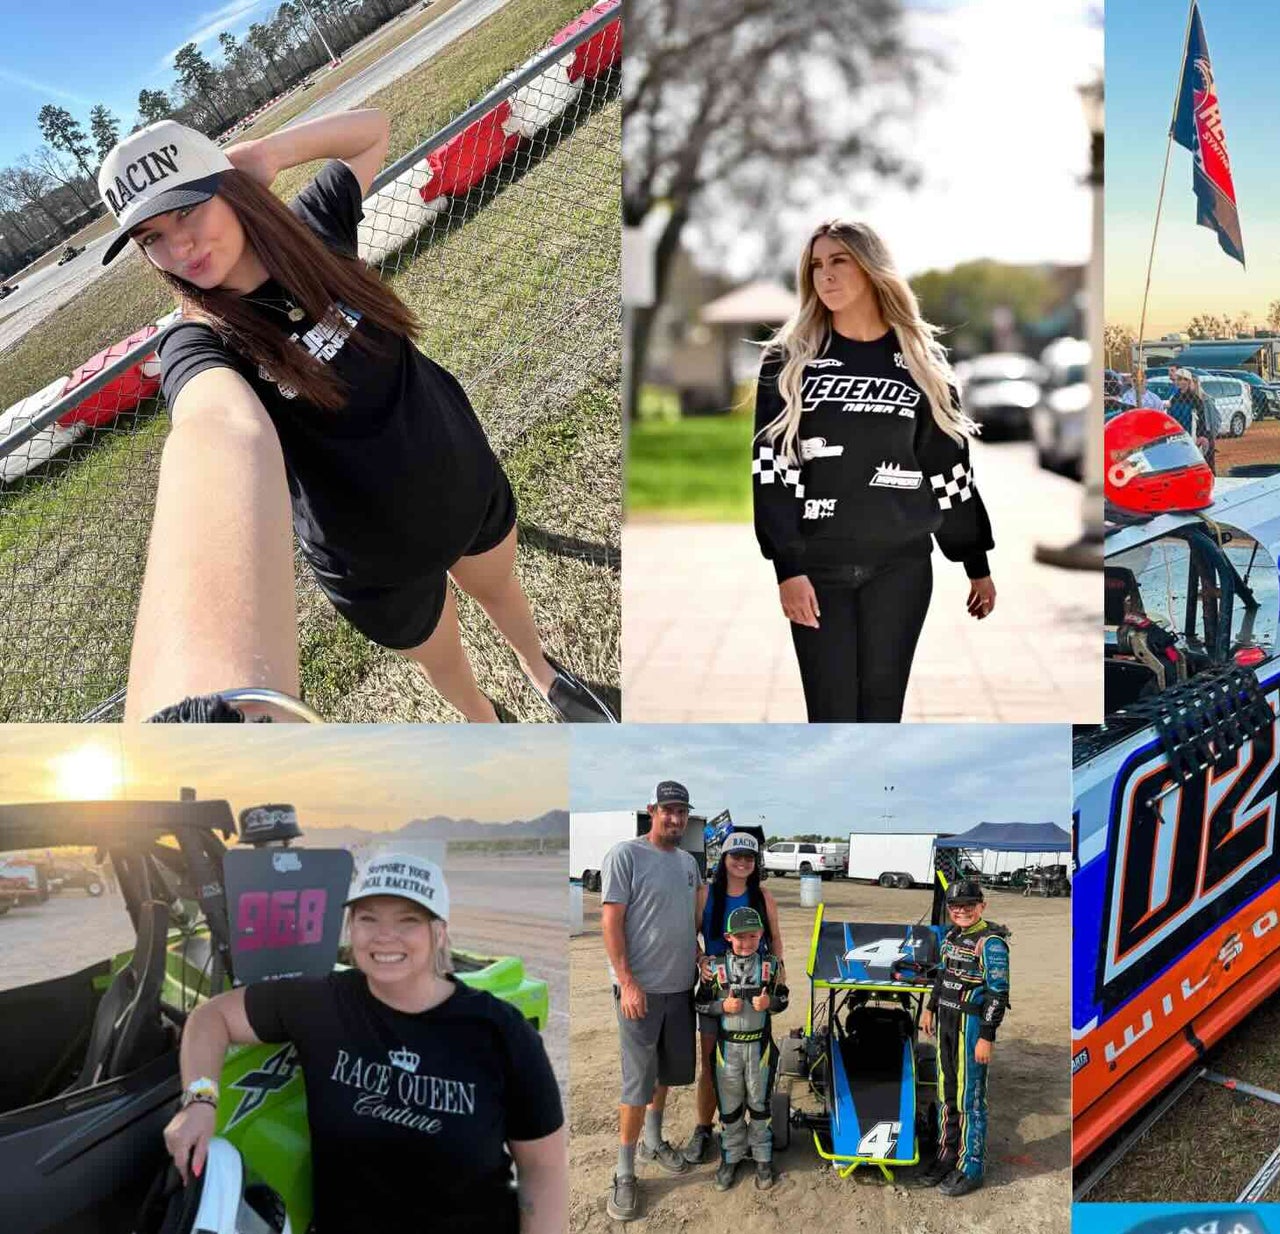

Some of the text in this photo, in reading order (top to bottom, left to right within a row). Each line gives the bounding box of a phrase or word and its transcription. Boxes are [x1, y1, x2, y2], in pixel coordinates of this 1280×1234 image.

[104, 143, 179, 218] RACIN'
[331, 1049, 477, 1115] RACE QUEEN
[352, 1093, 442, 1134] Couture
[856, 1121, 898, 1160] 4
